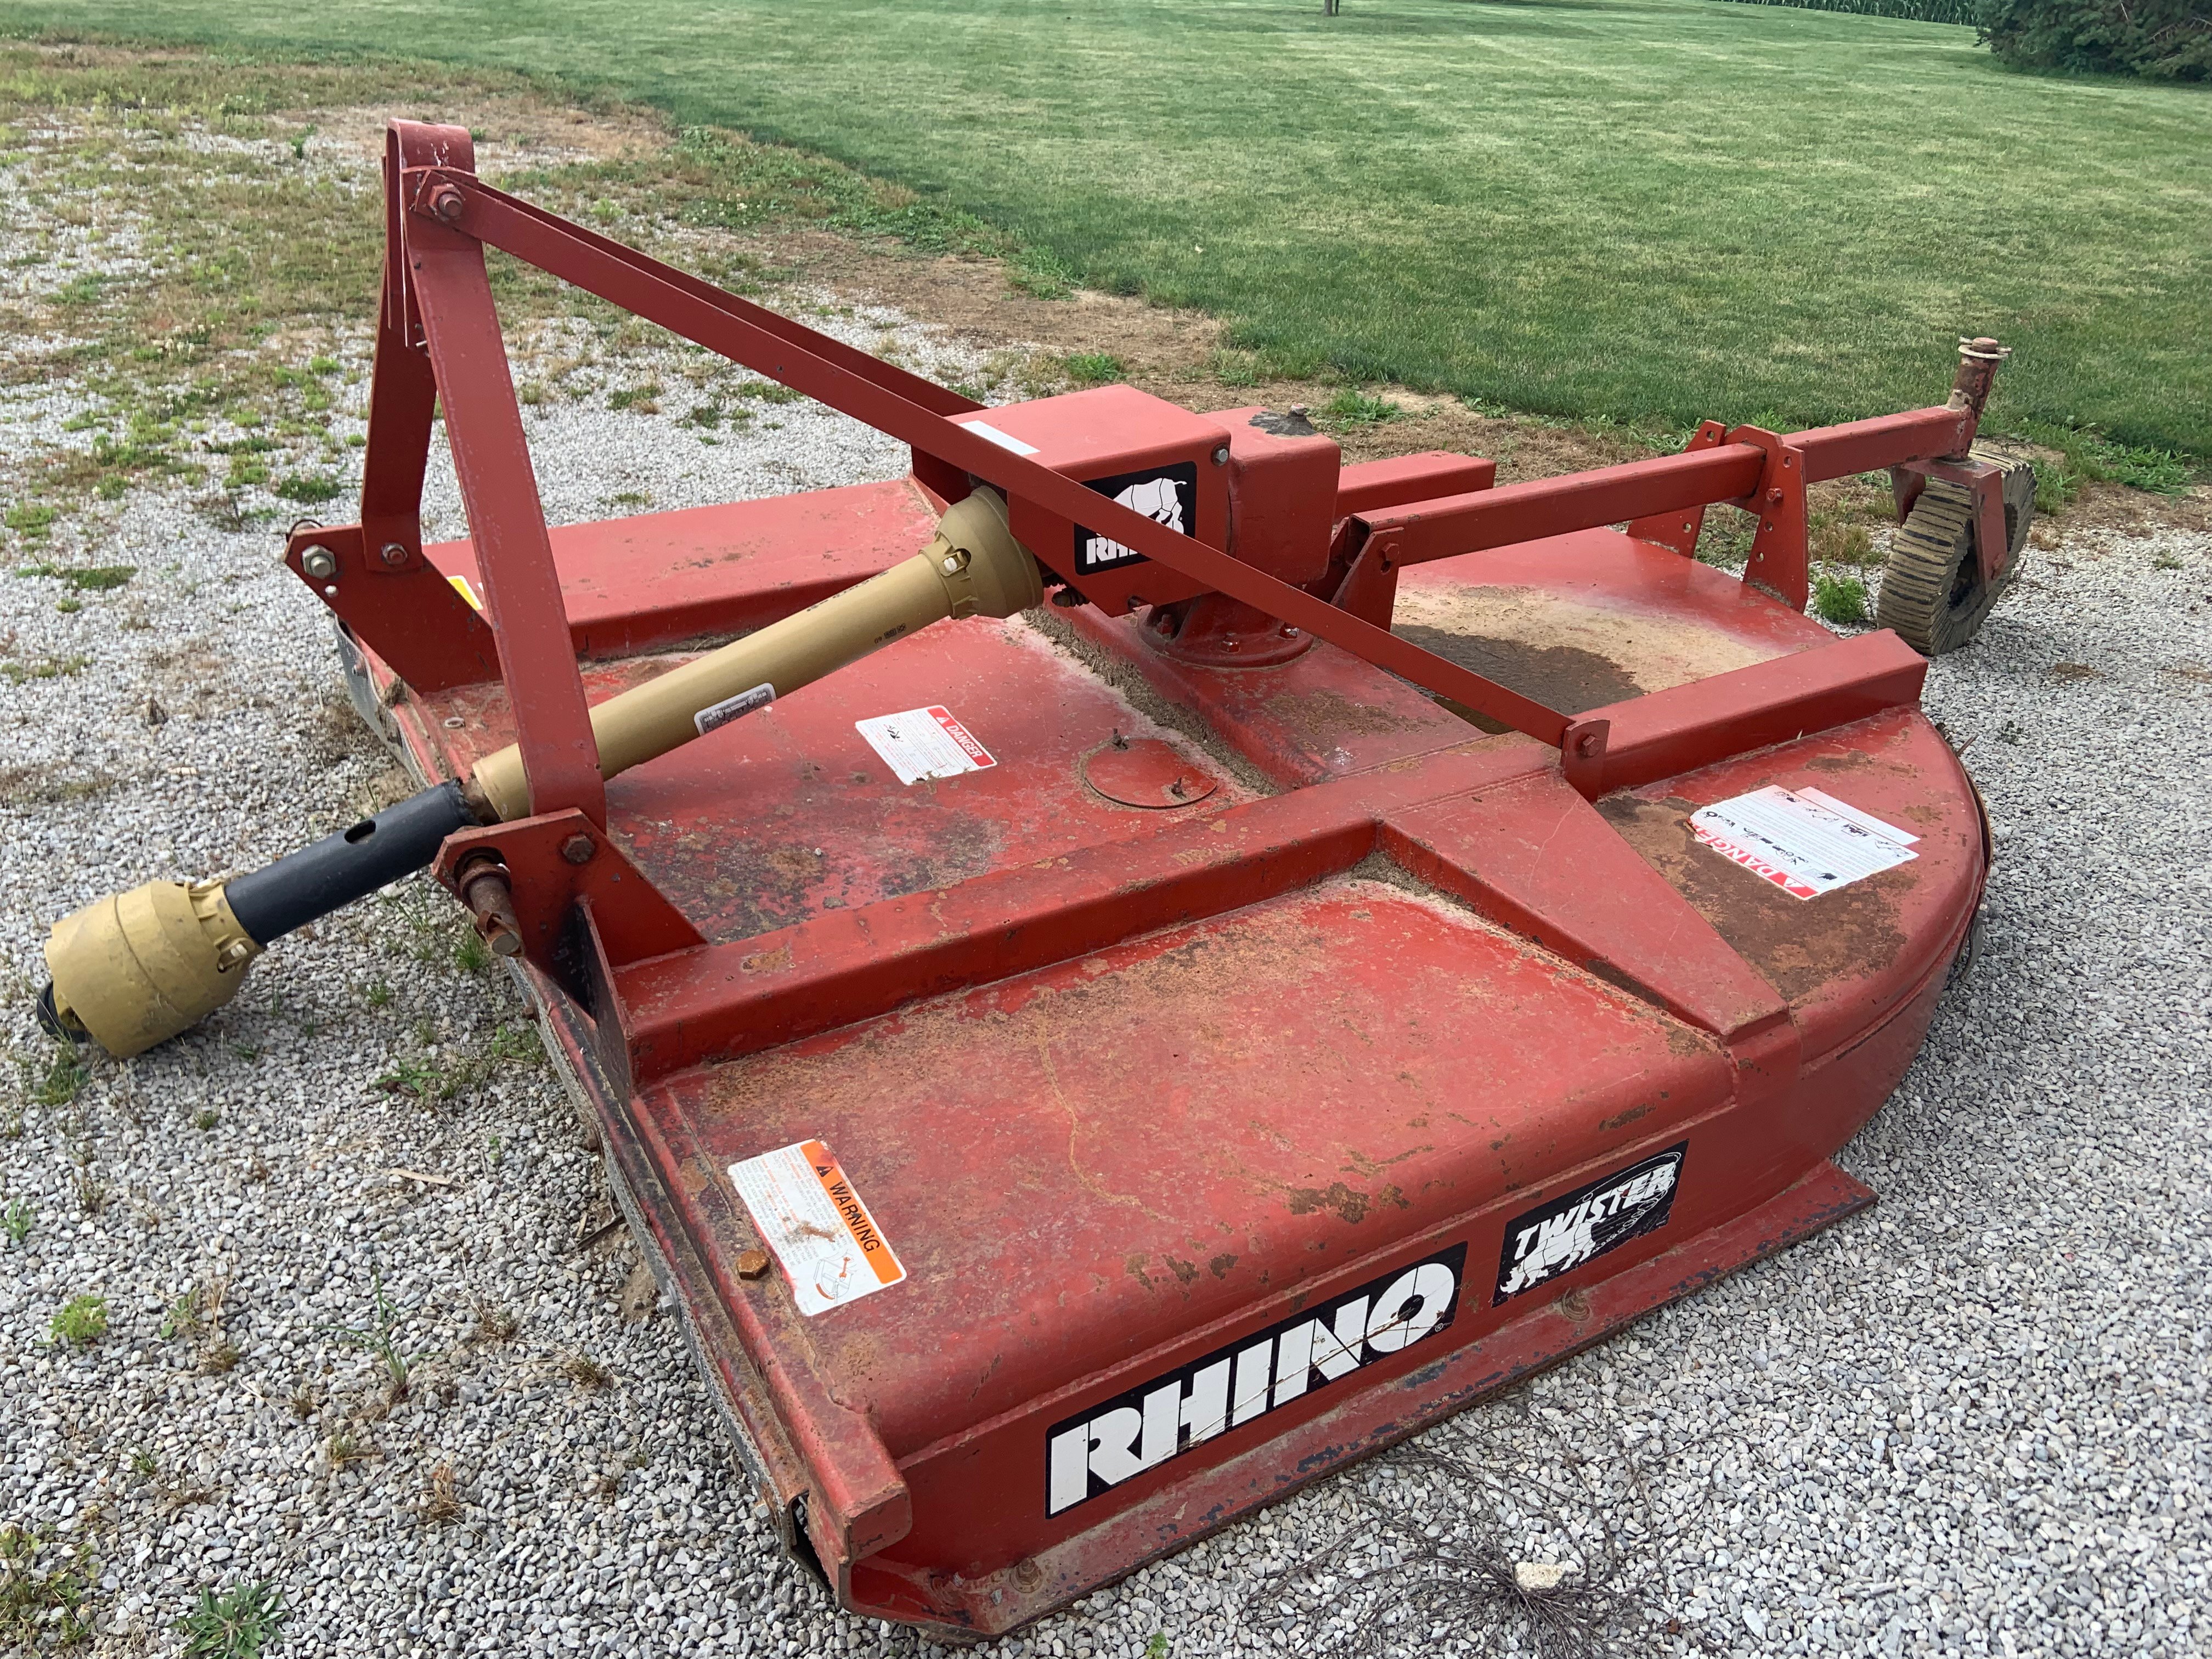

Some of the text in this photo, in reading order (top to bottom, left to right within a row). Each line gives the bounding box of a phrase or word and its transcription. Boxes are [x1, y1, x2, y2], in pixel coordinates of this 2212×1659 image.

[946, 725, 983, 758] DANGER
[830, 1182, 881, 1252] WARNING
[1515, 1161, 1675, 1260] TWISTER
[1050, 1263, 1455, 1515] RHINO
